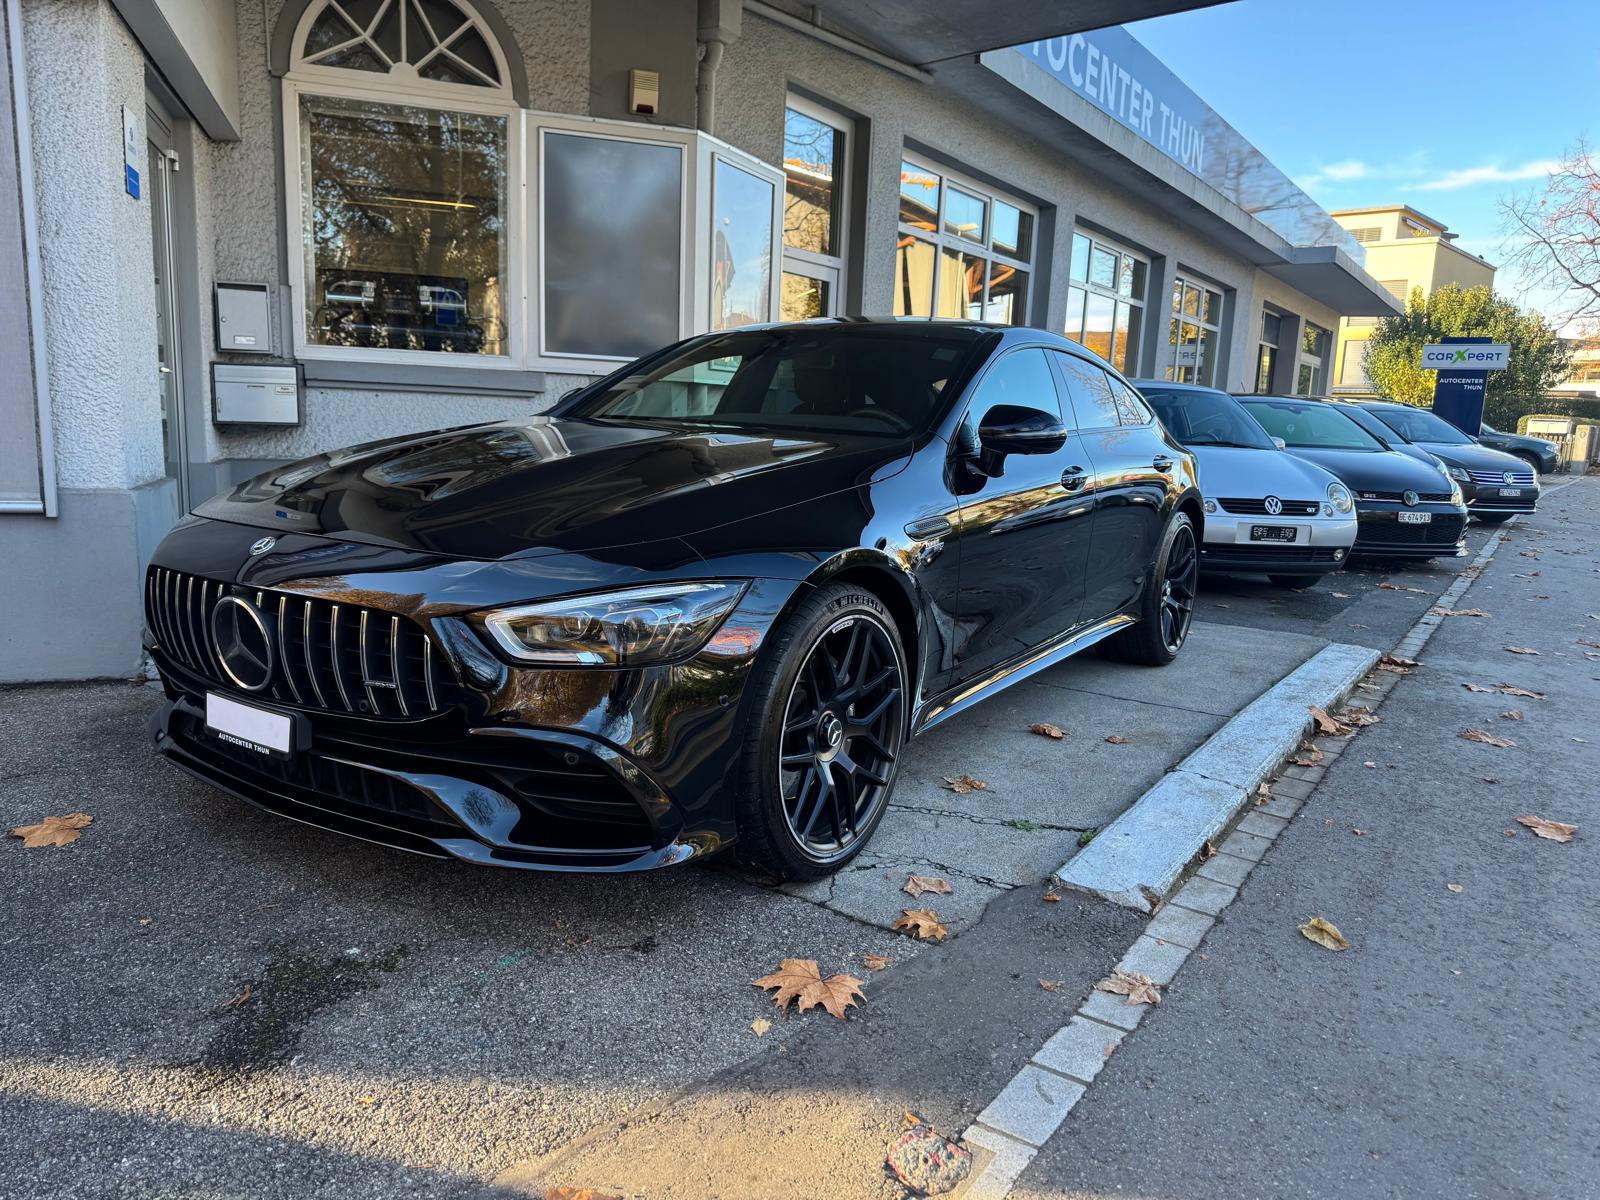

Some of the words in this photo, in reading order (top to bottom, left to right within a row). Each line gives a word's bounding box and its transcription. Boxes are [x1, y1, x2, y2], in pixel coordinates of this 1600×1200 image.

[1032, 33, 1154, 138] OCENTER
[1159, 102, 1205, 174] THUN
[1439, 377, 1484, 385] AUTOCENTER
[218, 732, 253, 750] AUTOCENTER
[253, 744, 270, 755] THUN
